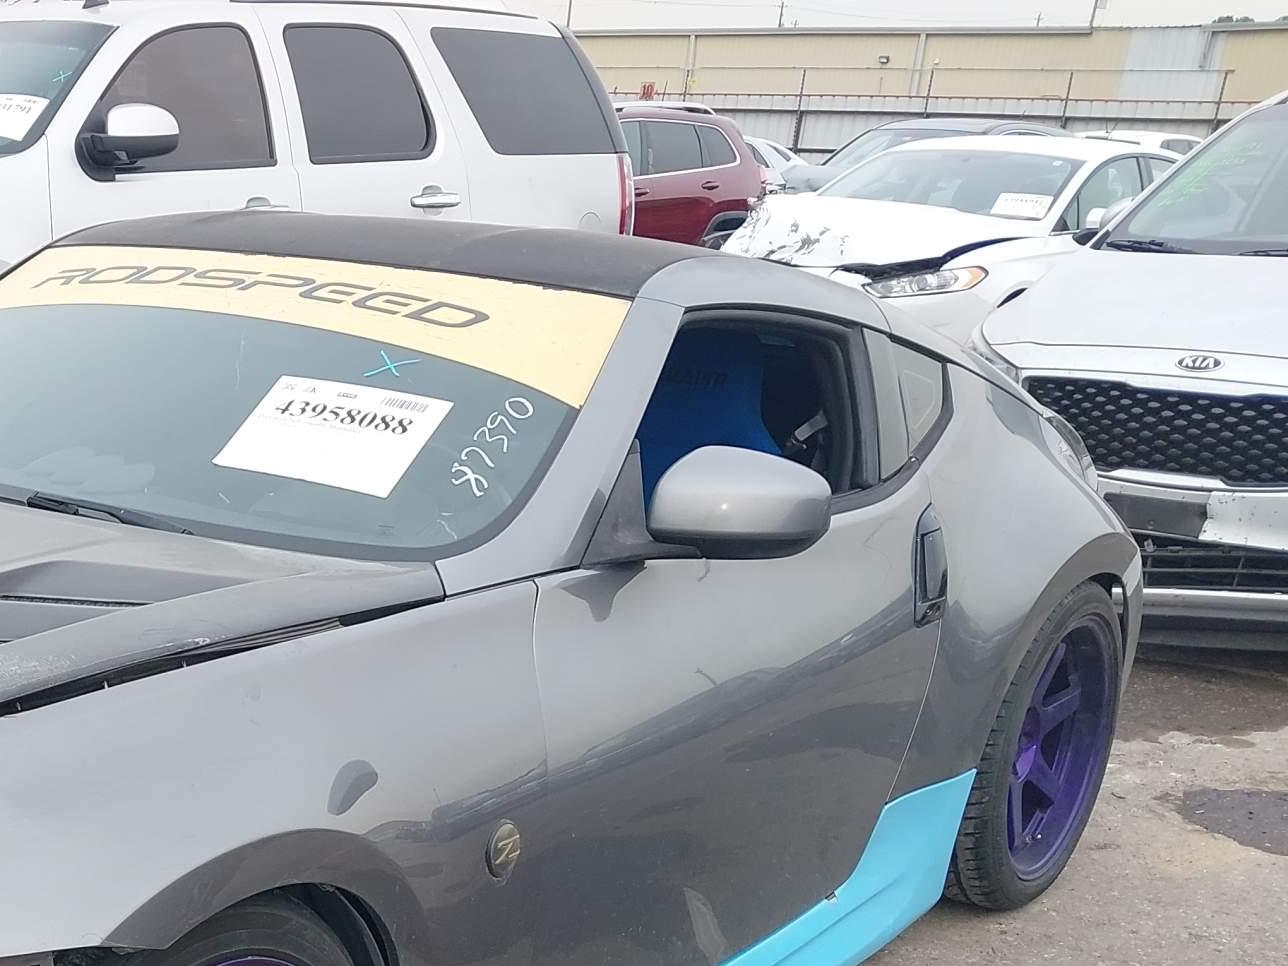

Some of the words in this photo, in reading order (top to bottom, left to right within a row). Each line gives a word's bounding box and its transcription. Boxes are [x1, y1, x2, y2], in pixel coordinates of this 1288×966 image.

[31, 265, 490, 328] RODSPEED
[1181, 356, 1215, 369] KIA
[274, 398, 414, 436] 43958088
